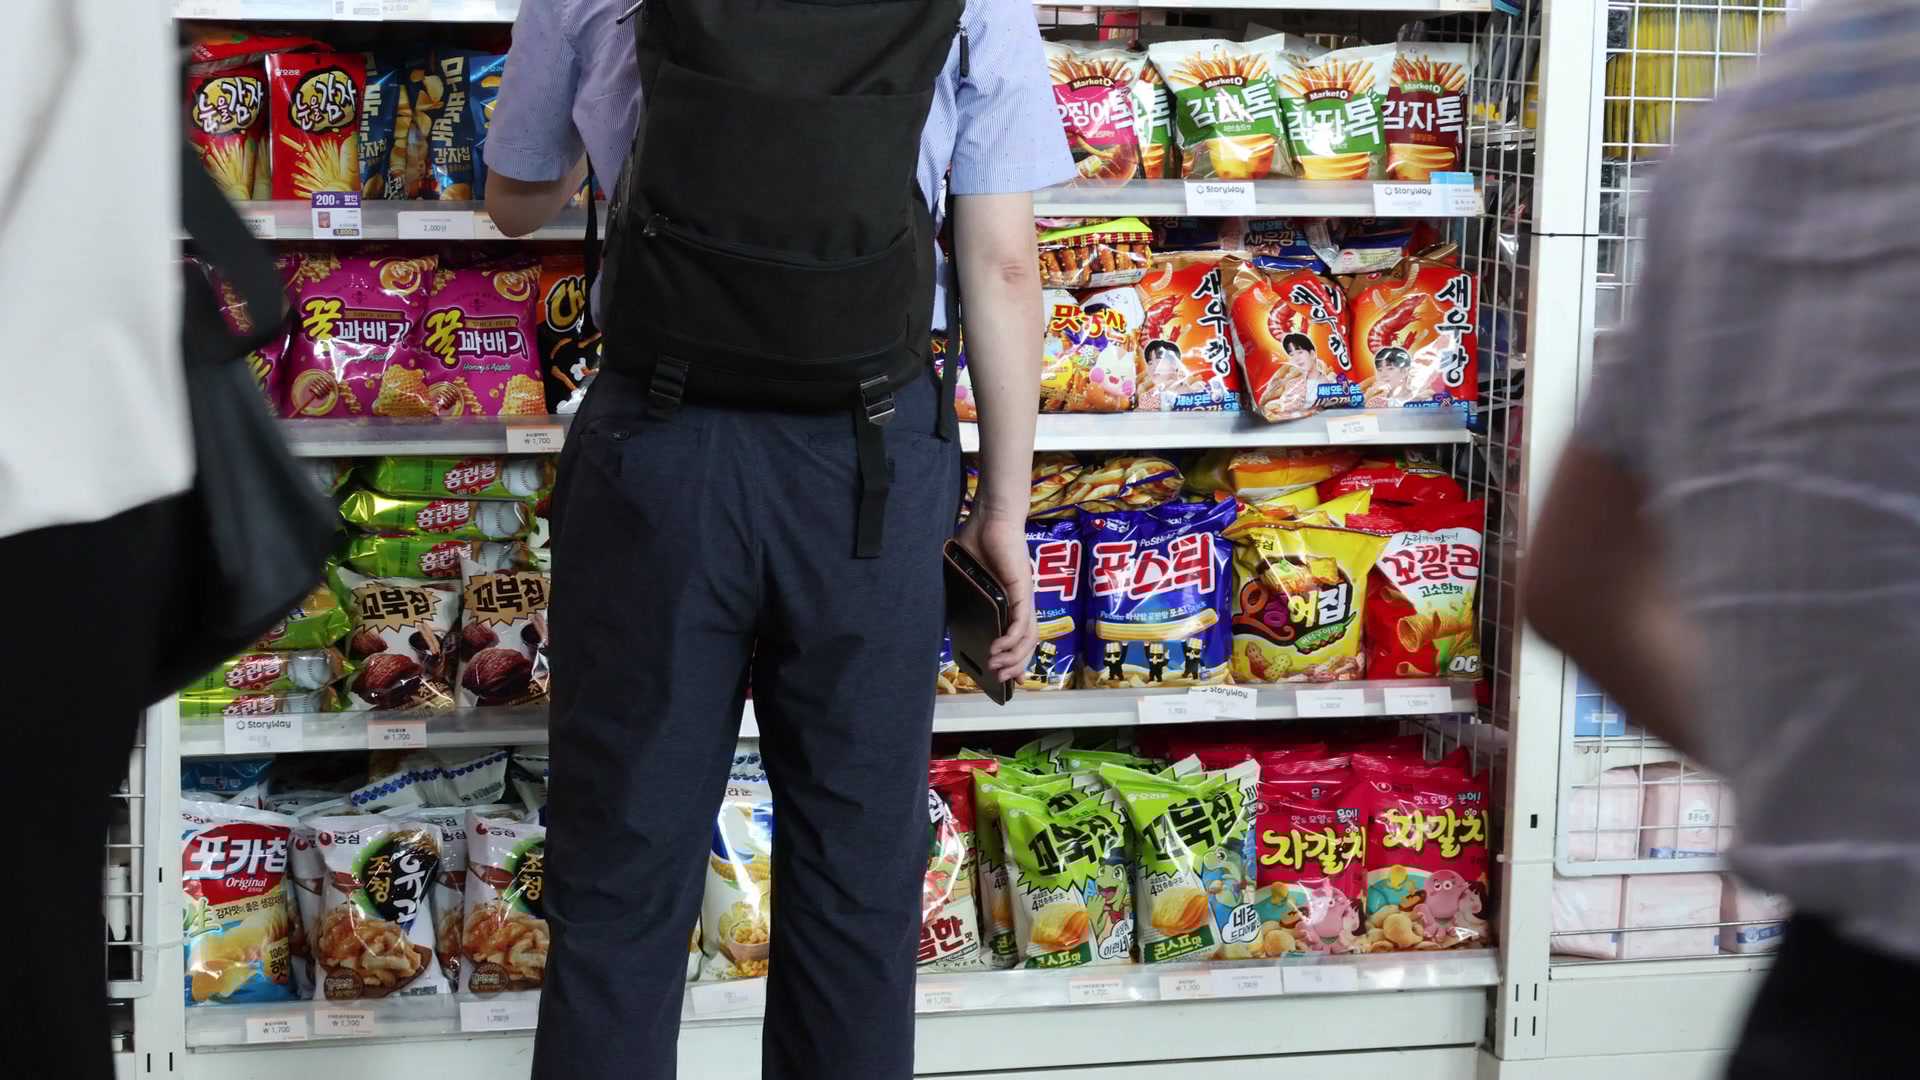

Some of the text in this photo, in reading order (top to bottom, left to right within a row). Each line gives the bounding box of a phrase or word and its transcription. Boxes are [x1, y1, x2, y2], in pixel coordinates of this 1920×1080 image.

[199, 77, 263, 132] 눈을감자
[296, 72, 357, 131] 눈을감자
[431, 57, 466, 147] 무뚝뚝
[1187, 83, 1280, 128] 감자톡
[1288, 98, 1380, 145] 감자톡
[1382, 95, 1464, 144] 감자톡
[433, 147, 470, 164] 감자칩
[1206, 185, 1245, 194] StoryWay
[1394, 187, 1432, 195] StoryWay
[423, 224, 447, 232] 2,000원
[1245, 230, 1296, 247] 새우깡
[303, 300, 411, 352] 꿀꽈배기
[425, 309, 528, 365] 꿀꽈배기
[1051, 303, 1127, 343] 맛동산
[1192, 268, 1231, 375] 새우깡
[1436, 274, 1473, 385] 새우깡
[445, 460, 496, 489] 홈런볼
[416, 501, 470, 528] 홈런볼
[1094, 532, 1215, 601] 포스틱
[1382, 543, 1480, 586] 꼬깔콘
[362, 588, 430, 620] 꼬북칩
[473, 578, 545, 613] 꼬북칩
[225, 655, 281, 688] 홈런볼
[247, 720, 292, 729] StoryWay
[392, 733, 411, 741] 1,700
[1430, 795, 1453, 804] 모양도
[334, 833, 359, 845] 농심
[1143, 792, 1237, 861] 꼬북칩
[1383, 808, 1489, 857] 자갈치
[184, 836, 288, 881] 포카칩
[1028, 814, 1121, 875] 꼬북칩
[1261, 826, 1367, 874] 자갈치
[226, 876, 267, 891] Original
[964, 930, 974, 940] 맛
[1154, 934, 1204, 961] 콘스프맛
[954, 959, 976, 967] NEW
[1092, 988, 1109, 996] 1,700
[272, 1026, 291, 1034] 1,700
